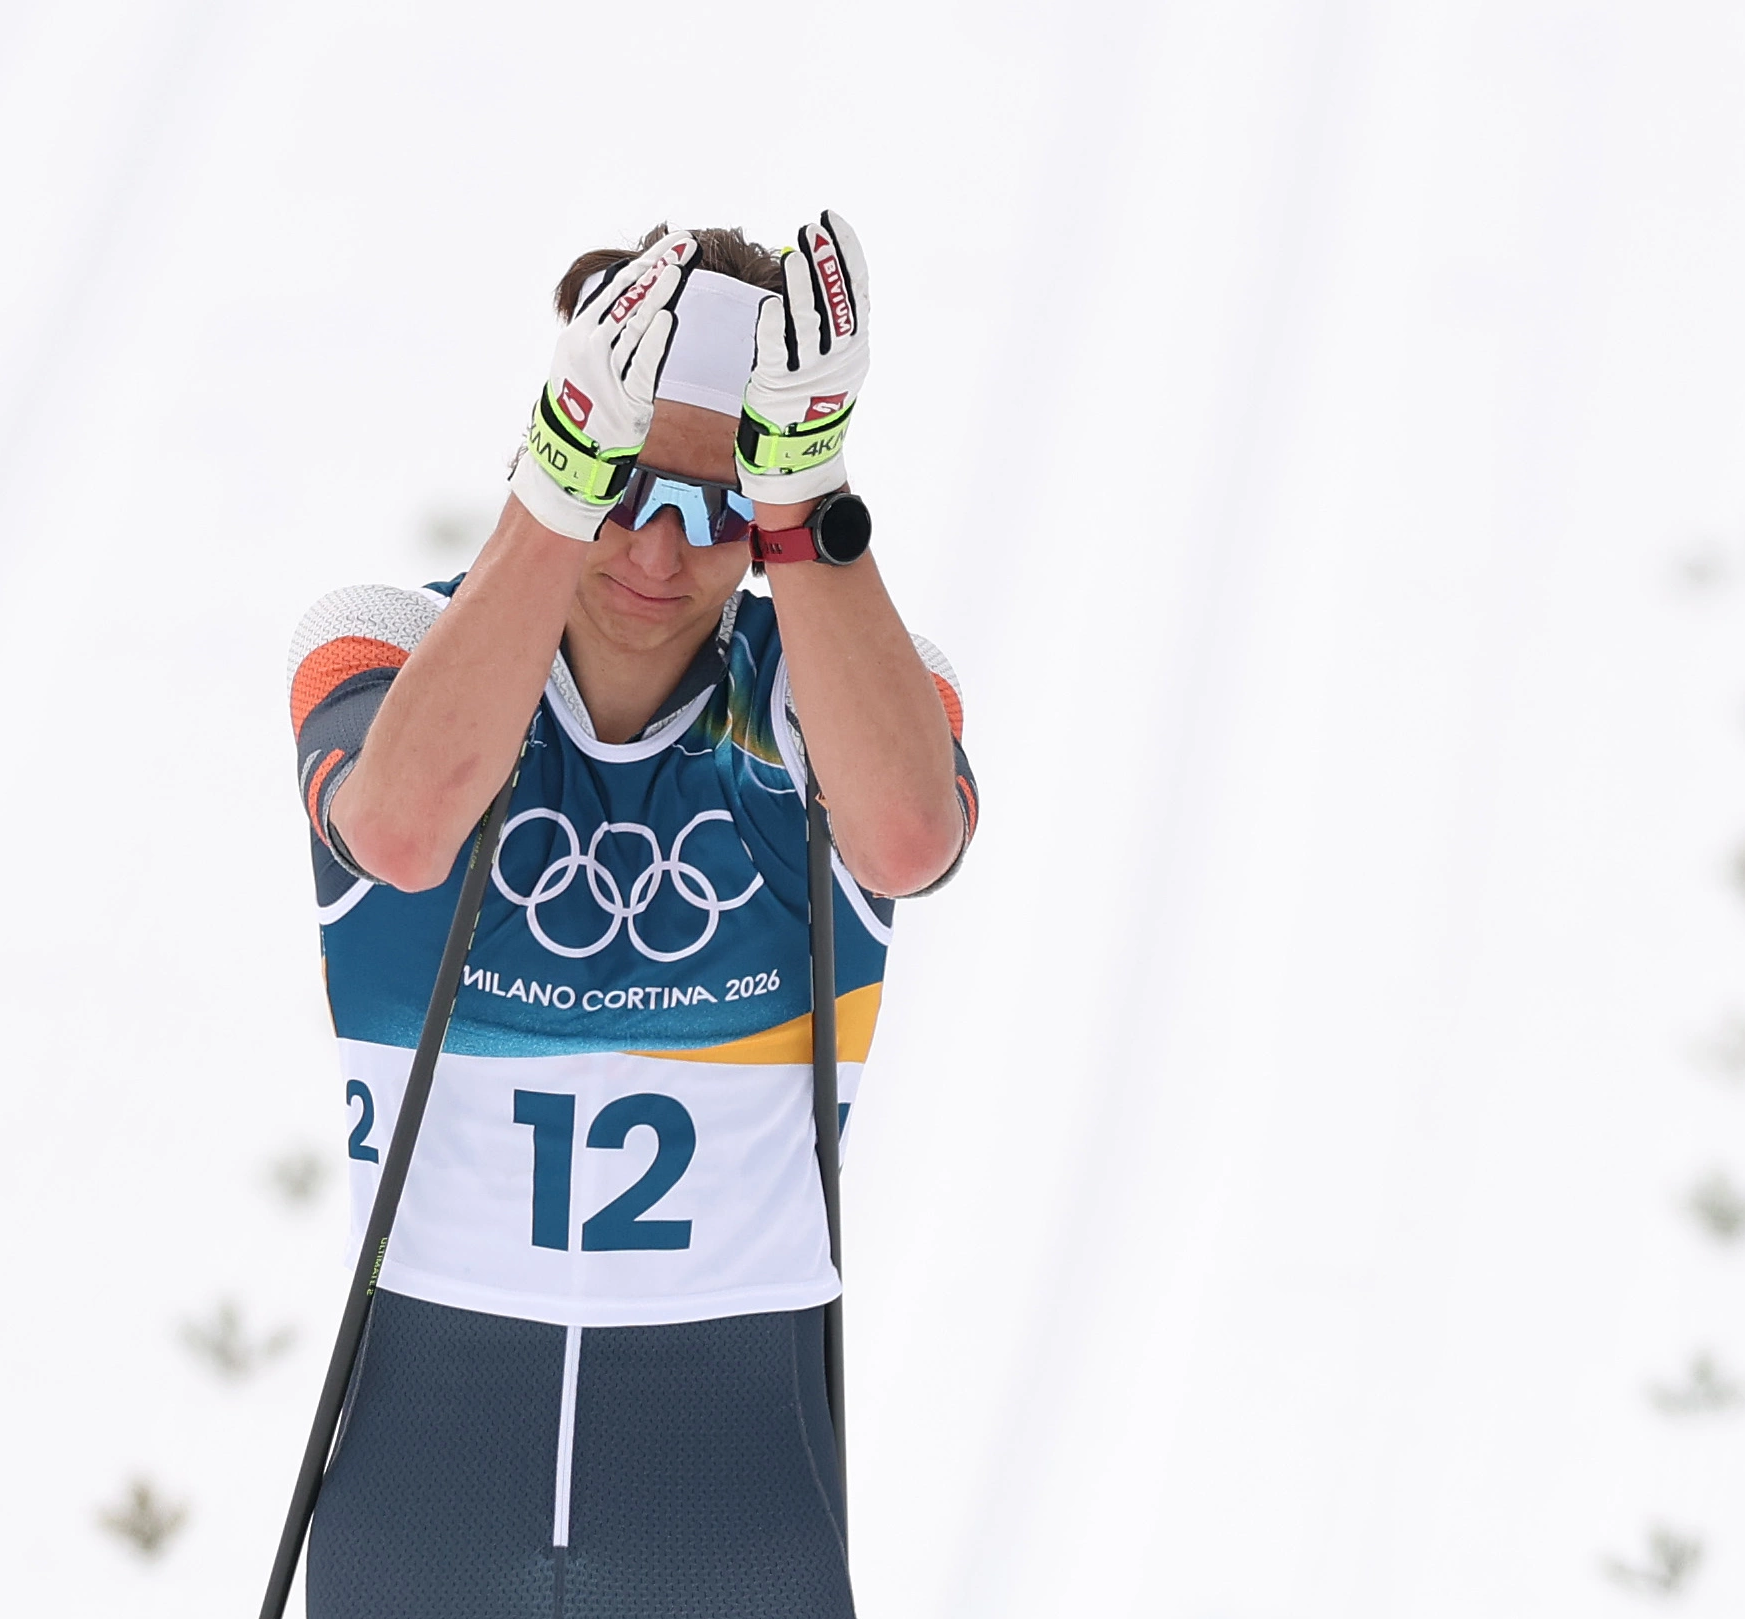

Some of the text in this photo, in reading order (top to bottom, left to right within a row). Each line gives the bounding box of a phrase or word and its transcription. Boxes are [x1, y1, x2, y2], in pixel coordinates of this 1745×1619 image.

[823, 259, 851, 333] BIVIUM
[463, 965, 781, 1012] MILANO CORTINA 2026
[513, 1088, 697, 1252] 12
[368, 1237, 388, 1287] ULTIMATE
